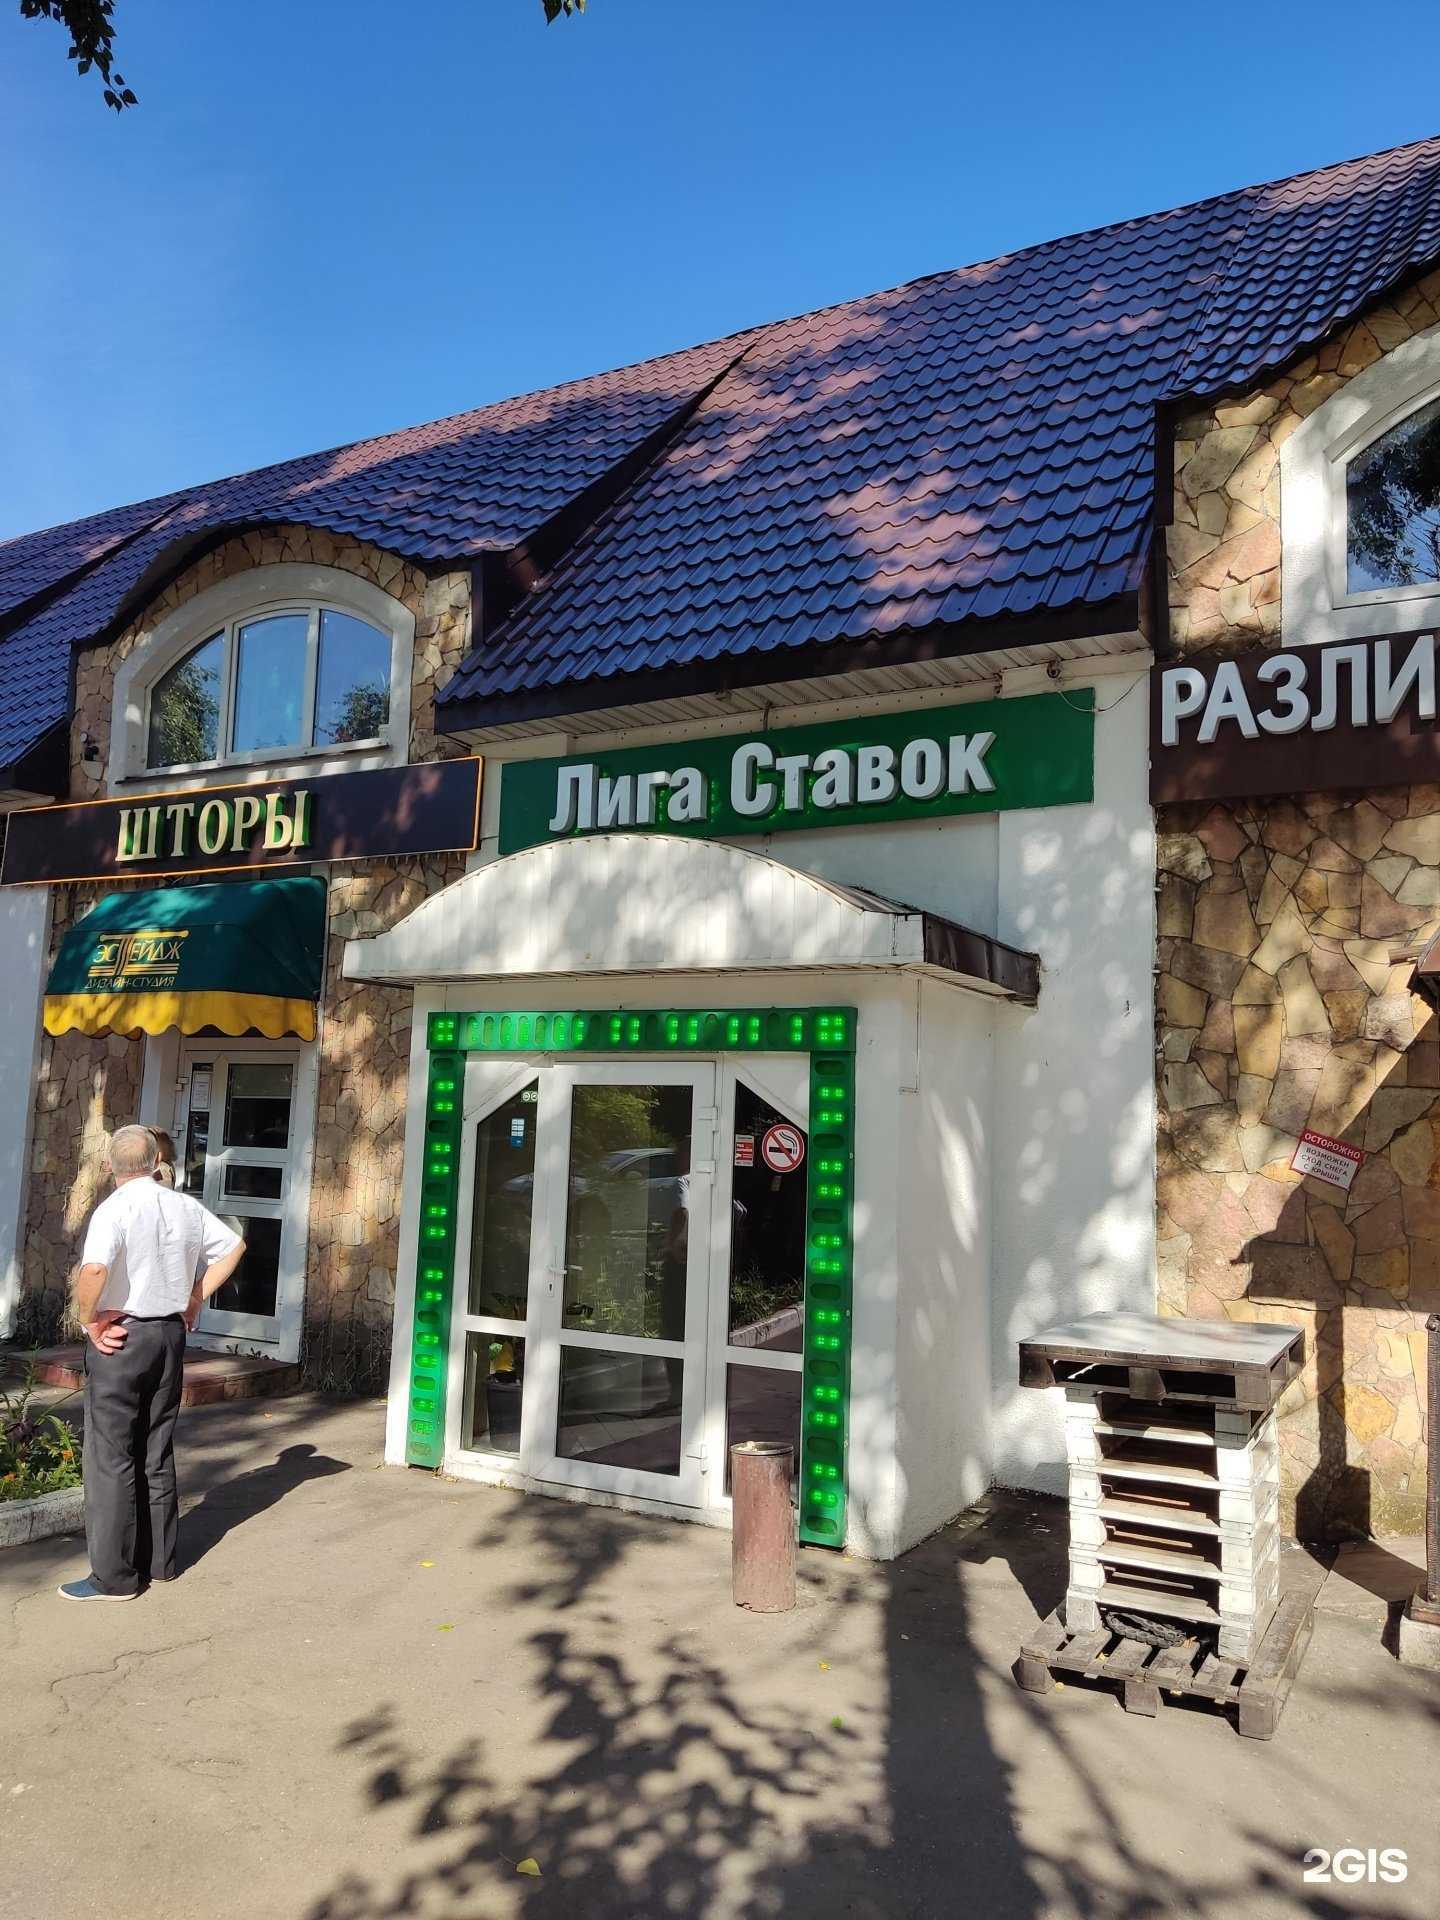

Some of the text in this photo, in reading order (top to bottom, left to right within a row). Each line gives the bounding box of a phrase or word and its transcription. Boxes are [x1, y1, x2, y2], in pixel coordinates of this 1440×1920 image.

[1161, 634, 1436, 746] РАЗЛИ
[549, 731, 997, 832] Лига Ставок
[115, 790, 311, 862] ШТОРЫ
[84, 976, 175, 989] ДИЗАЙН-СТУДИЯ
[1304, 1132, 1361, 1159] ОСТОРОЖНО
[1306, 1147, 1350, 1168] ВОЗМОЖЕН
[1301, 1154, 1348, 1177] СХОД СНЕГА
[1312, 1166, 1340, 1181] КРЫШИ
